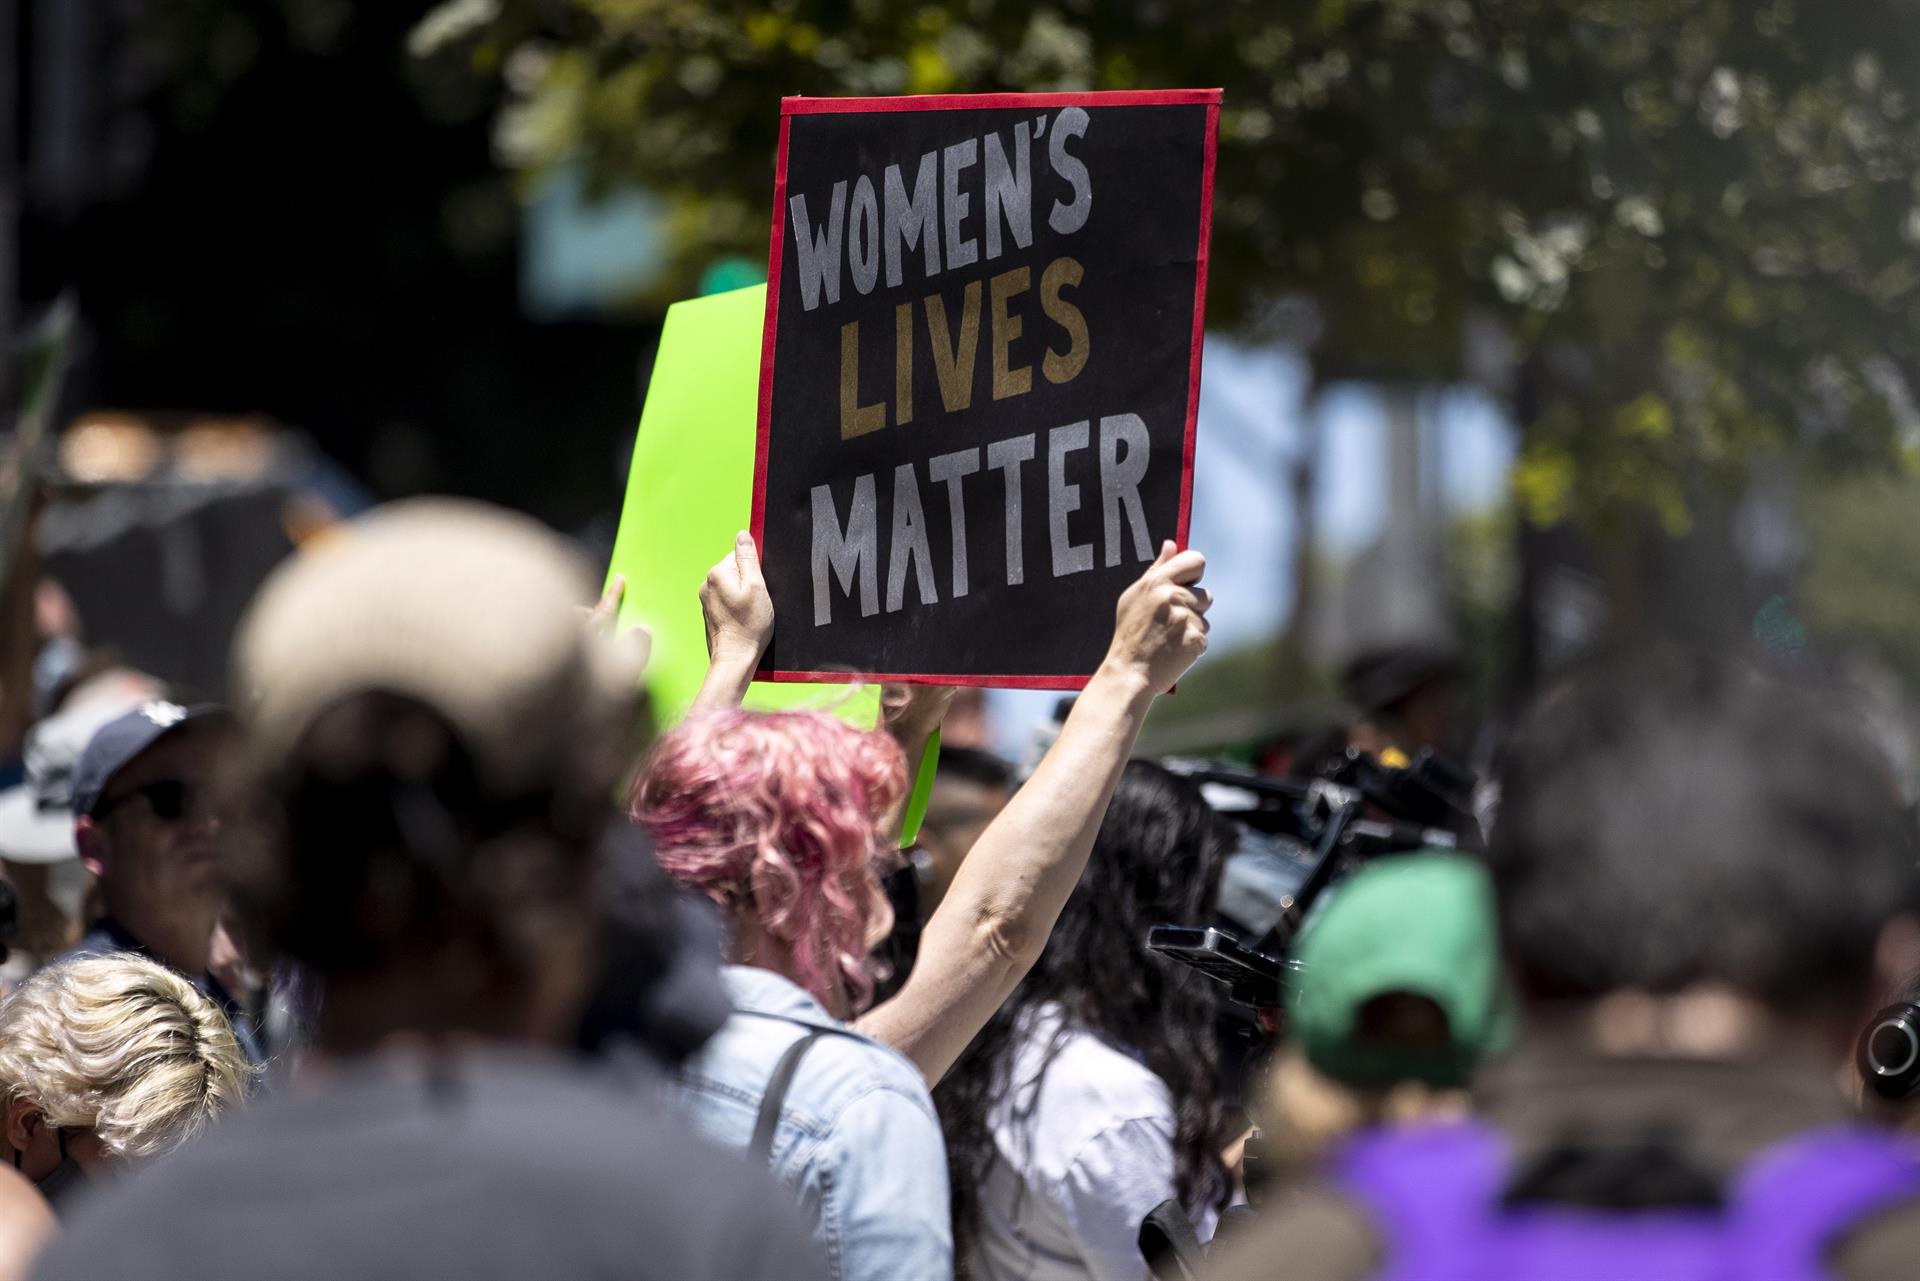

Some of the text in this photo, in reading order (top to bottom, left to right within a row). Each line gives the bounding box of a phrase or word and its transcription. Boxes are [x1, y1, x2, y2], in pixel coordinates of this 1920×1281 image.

[789, 107, 1092, 311] WOMEN'S
[841, 257, 1091, 440] LIVES
[811, 413, 1155, 626] MATTER
